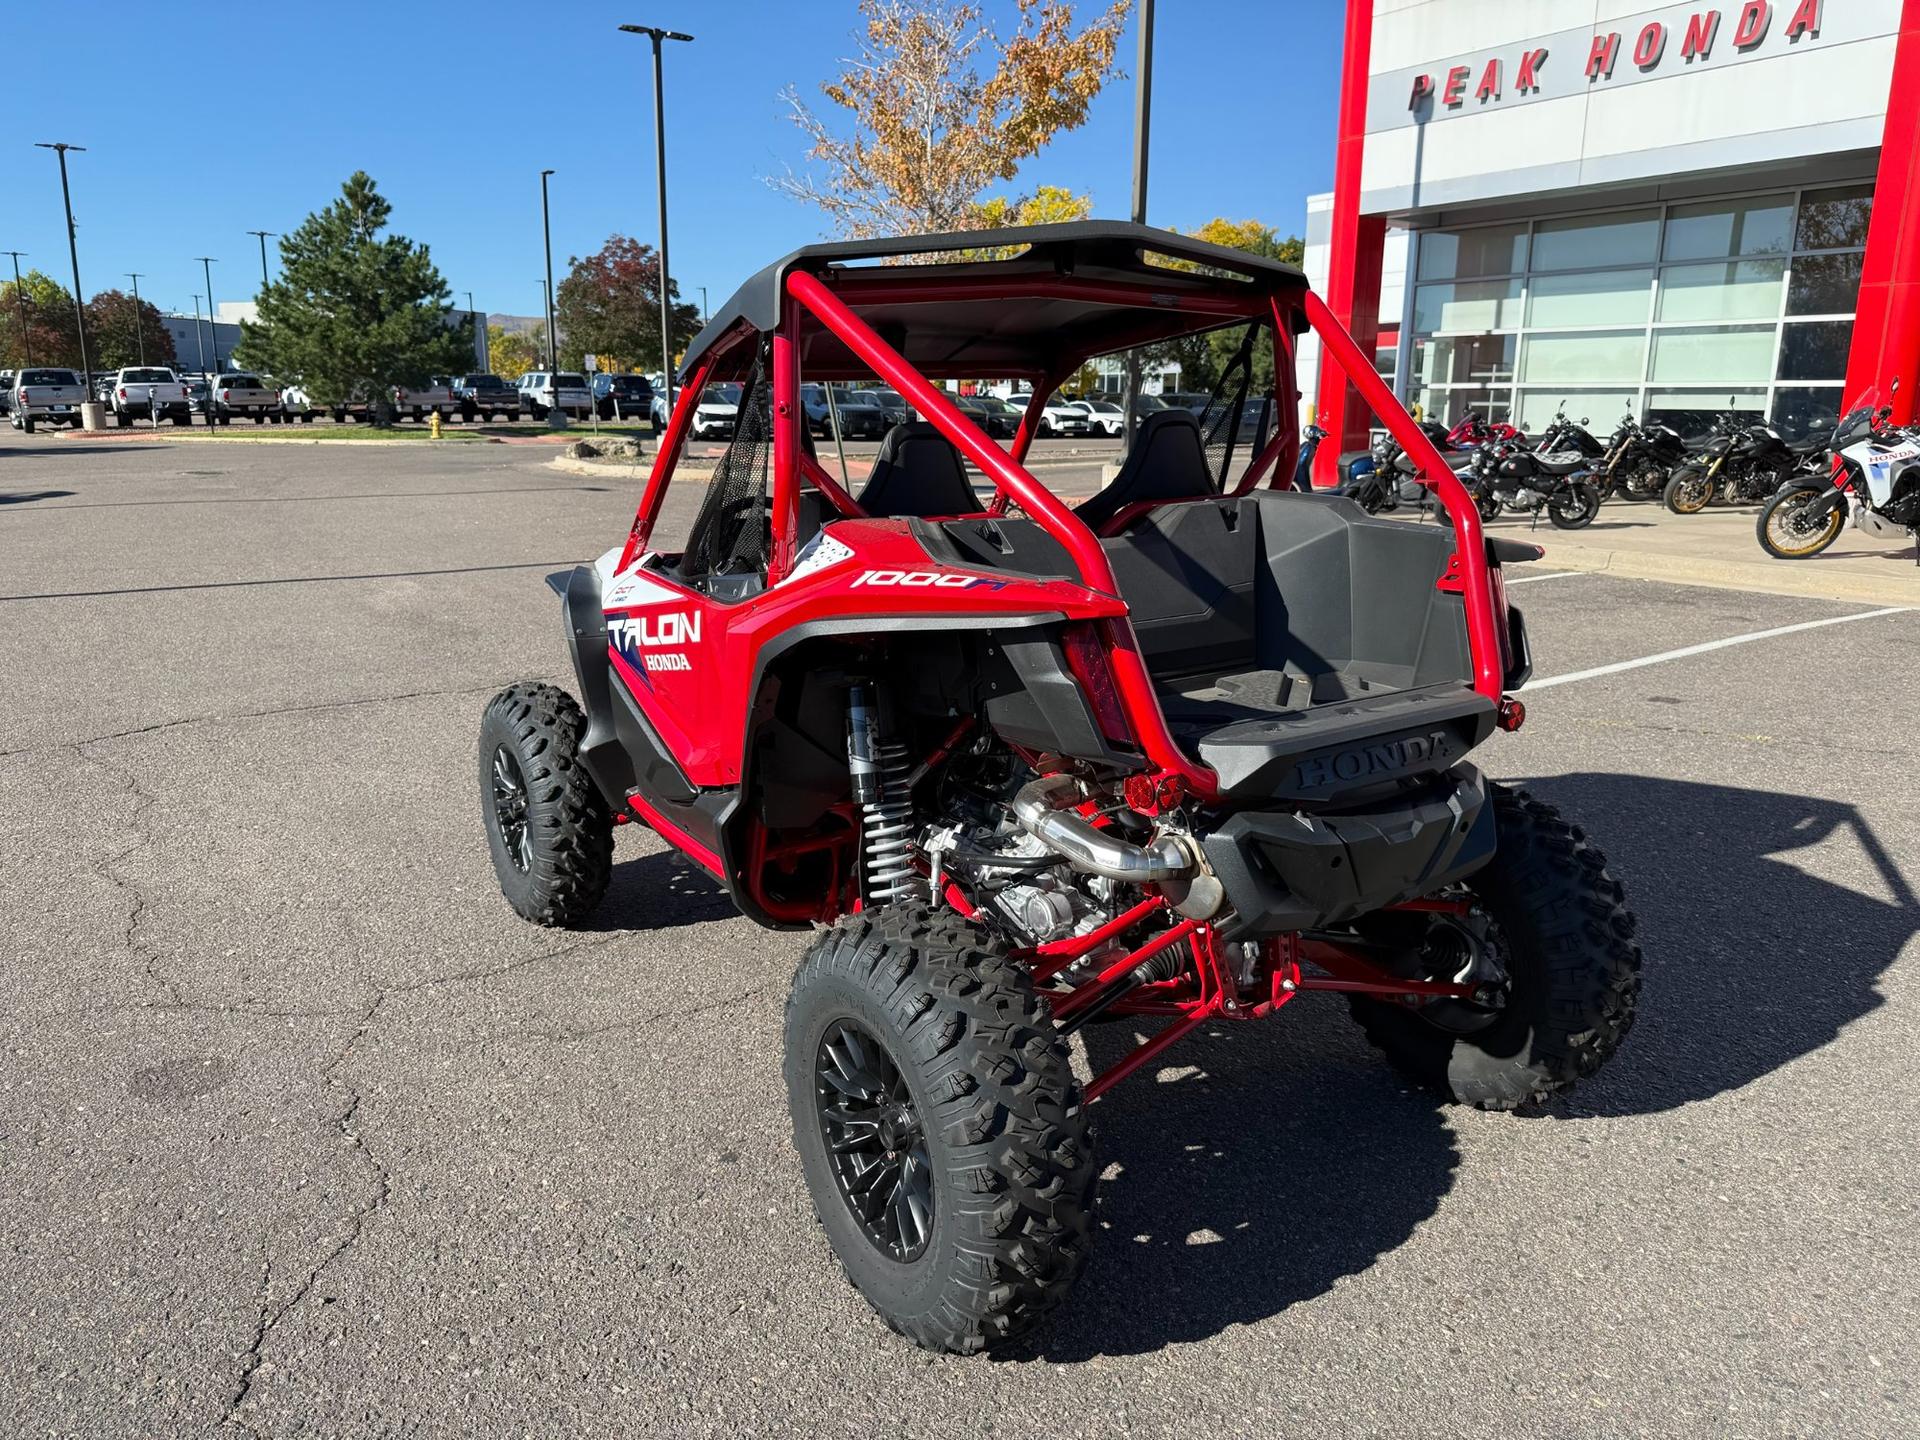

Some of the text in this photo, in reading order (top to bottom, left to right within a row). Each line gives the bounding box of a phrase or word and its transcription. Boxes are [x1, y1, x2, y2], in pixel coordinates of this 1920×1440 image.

[1408, 0, 1824, 111] PEAK HONDA
[1869, 449, 1915, 463] HONDA
[607, 610, 701, 652] TALON
[644, 653, 692, 671] HONDA
[1295, 731, 1451, 790] HONDA
